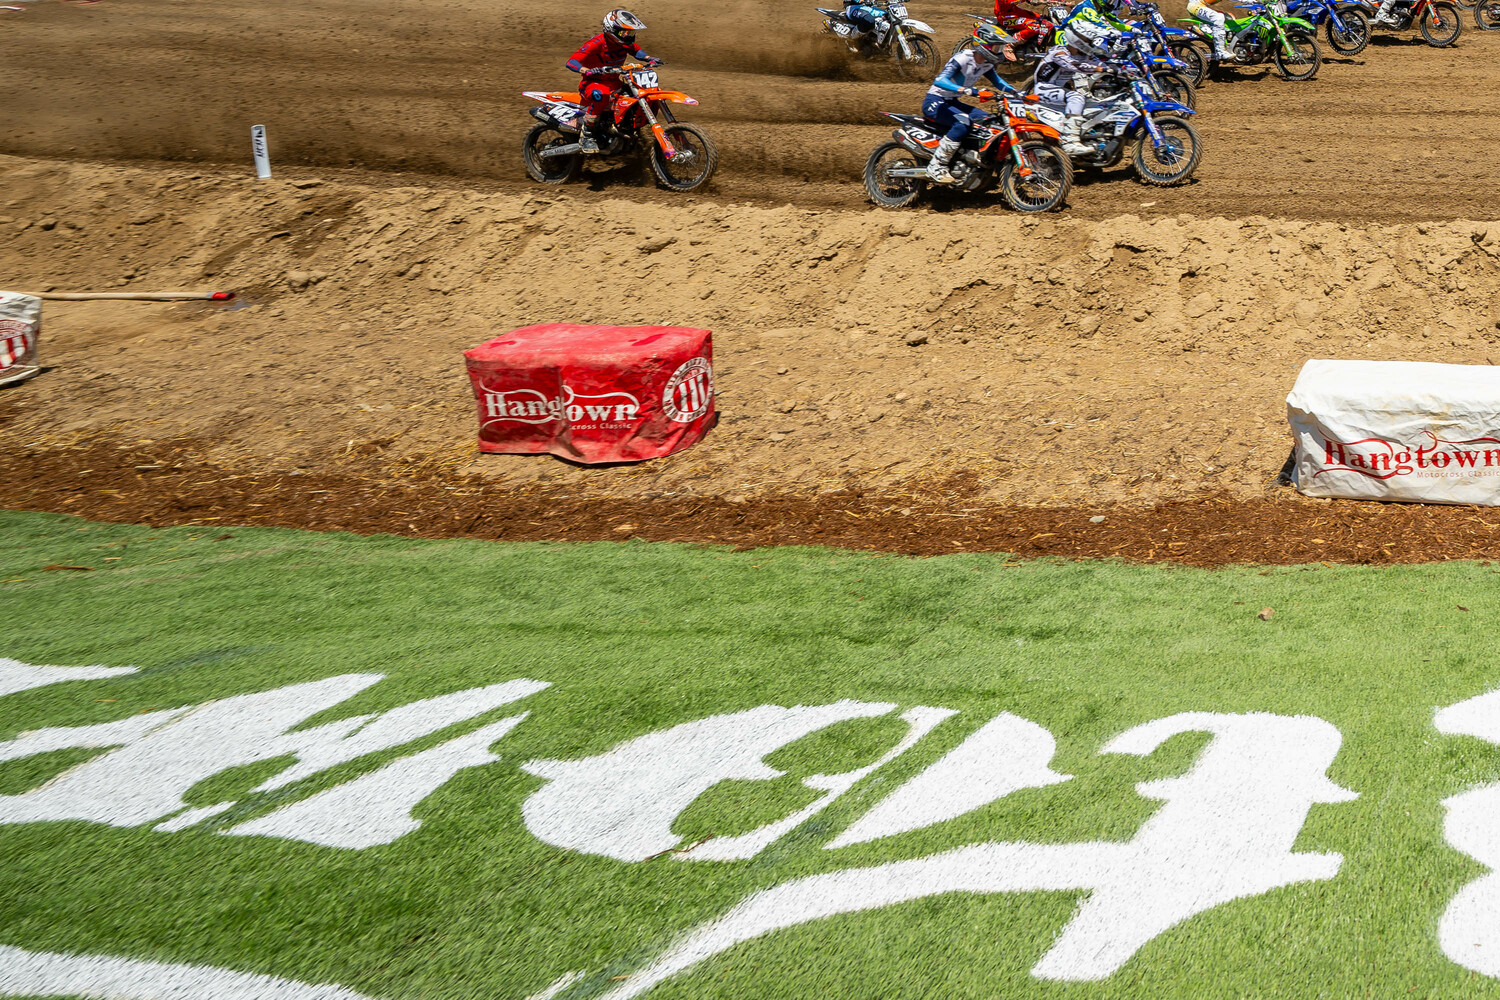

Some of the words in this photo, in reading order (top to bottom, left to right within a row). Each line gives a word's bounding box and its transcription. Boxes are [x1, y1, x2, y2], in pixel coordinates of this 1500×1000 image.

[833, 22, 850, 34] 310
[635, 72, 658, 88] 142
[549, 104, 576, 121] 142
[599, 422, 632, 430] Classic
[1416, 471, 1464, 479] Motocross
[1468, 470, 1500, 478] Classic
